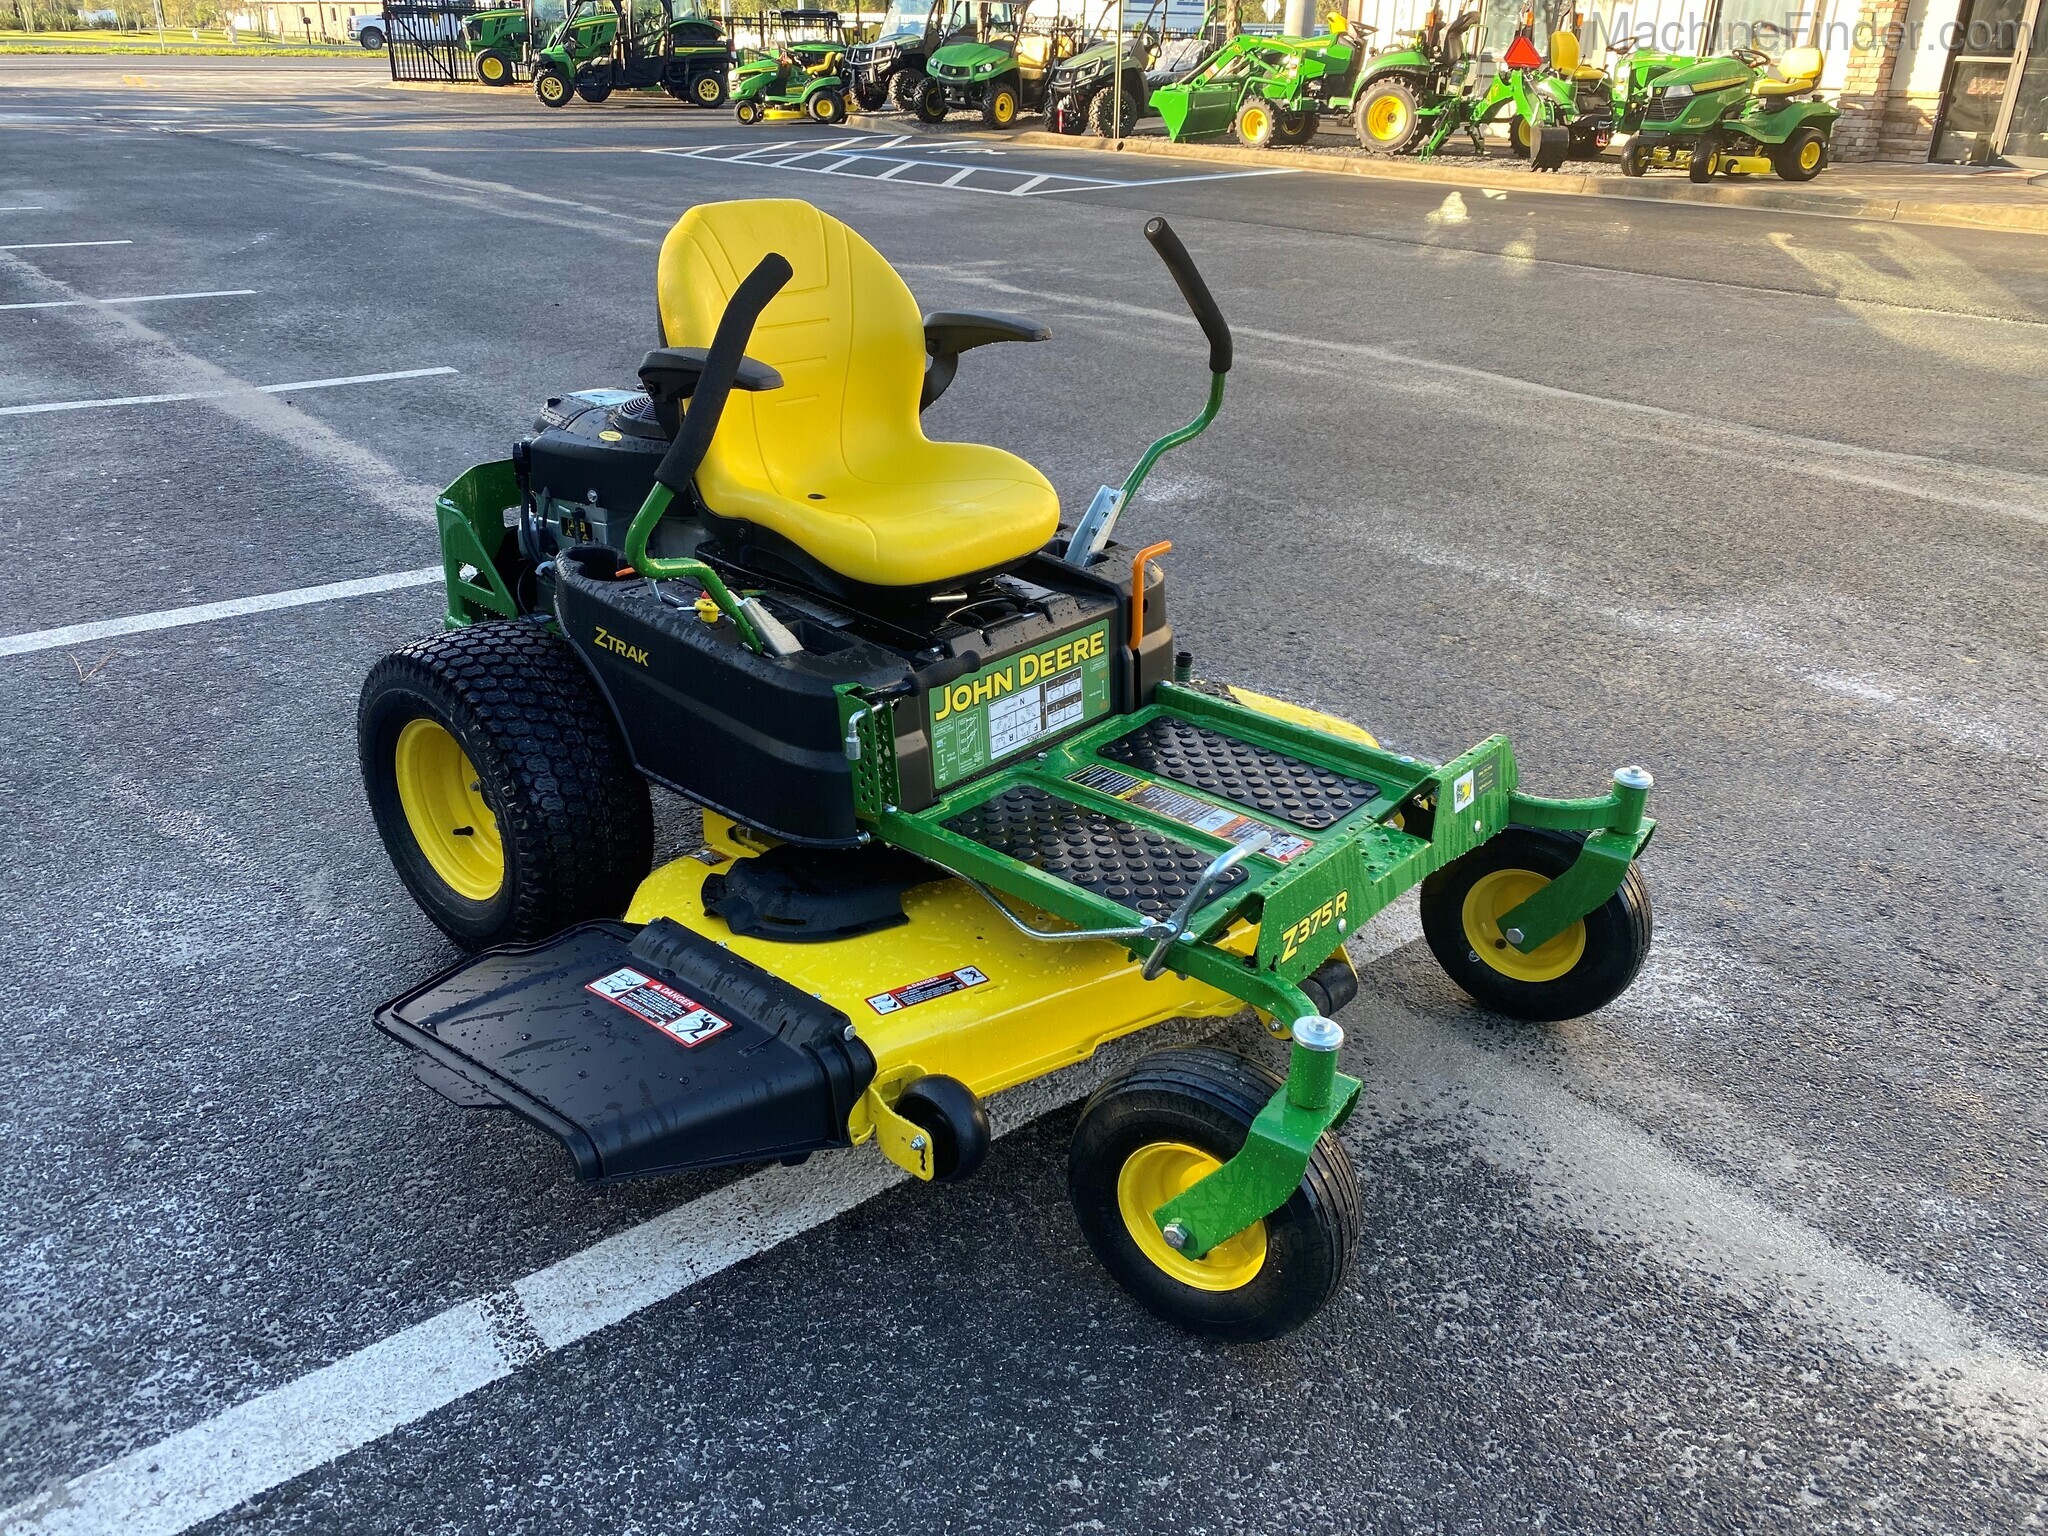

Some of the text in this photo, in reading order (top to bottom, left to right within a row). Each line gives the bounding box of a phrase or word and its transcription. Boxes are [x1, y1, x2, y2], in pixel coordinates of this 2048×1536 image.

[594, 626, 649, 667] ZTRAK
[935, 630, 1105, 721] JOHN DEERE
[660, 985, 696, 1008] DANGER
[911, 976, 940, 988] DANGER
